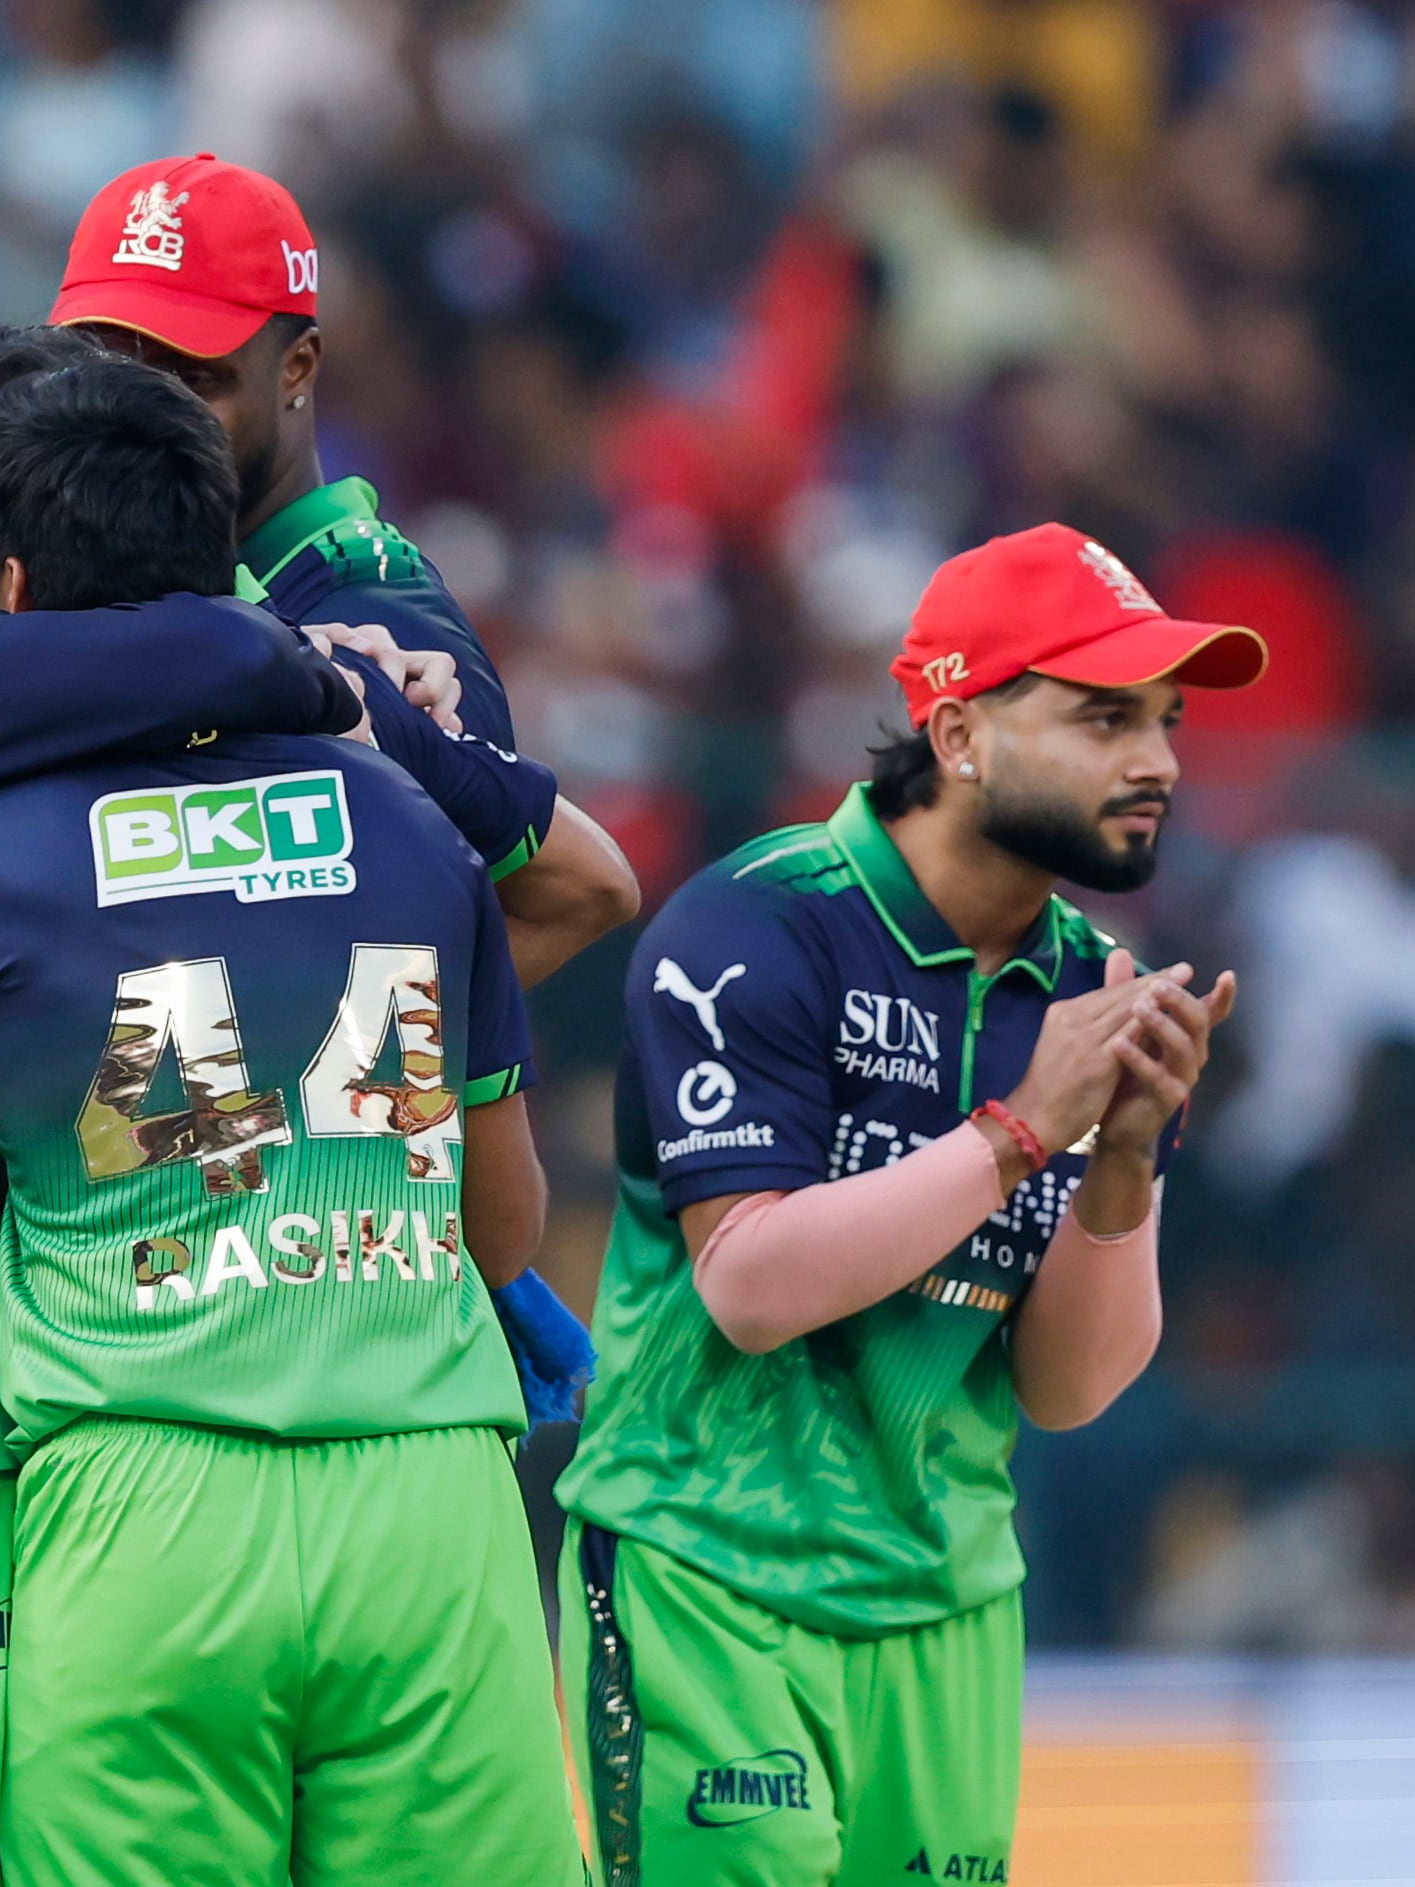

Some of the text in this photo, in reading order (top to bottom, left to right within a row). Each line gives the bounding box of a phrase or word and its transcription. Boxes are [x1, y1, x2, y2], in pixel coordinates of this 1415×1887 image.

[119, 227, 184, 261] RCB
[921, 651, 971, 692] 172
[103, 793, 333, 864] BKT
[239, 866, 349, 895] TYRES
[840, 988, 941, 1061] SUN
[74, 942, 465, 1201] 44
[131, 1209, 461, 1311] RASIKH
[697, 1767, 810, 1810] EMMVEE
